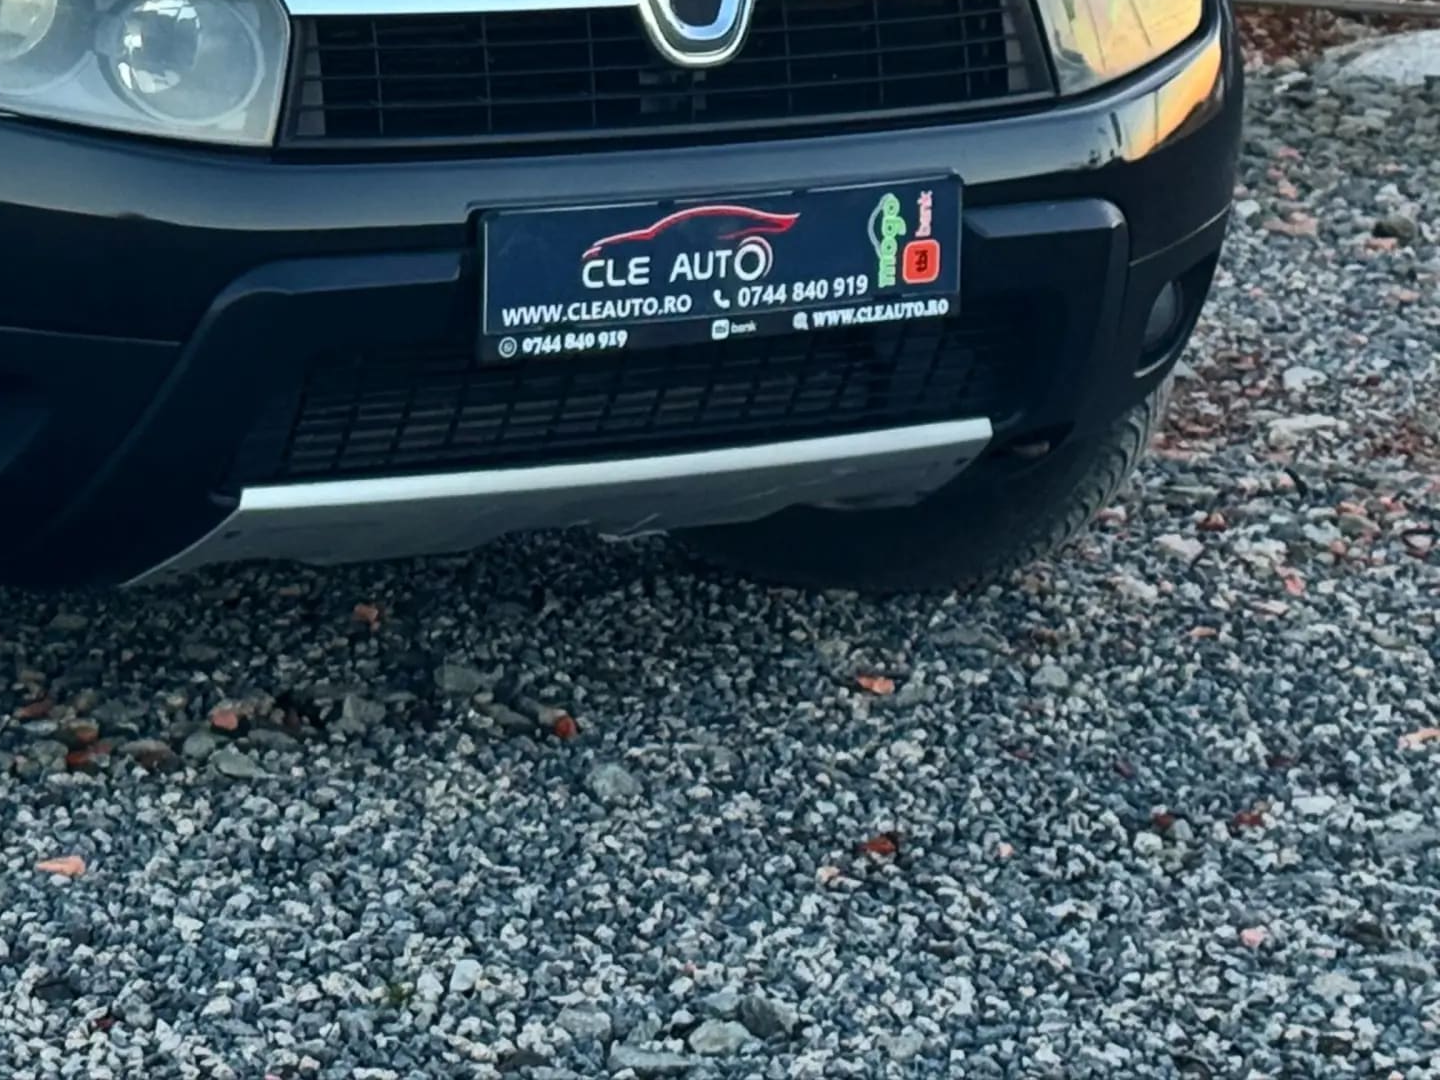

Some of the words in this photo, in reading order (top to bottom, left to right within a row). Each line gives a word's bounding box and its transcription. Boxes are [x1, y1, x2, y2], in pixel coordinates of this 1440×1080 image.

[582, 256, 650, 289] CLE
[670, 242, 768, 283] AUTO
[502, 293, 693, 327] WWW.CLEAUTO.RO
[737, 286, 787, 307] 0744
[792, 281, 829, 302] 840
[832, 274, 869, 298] 919
[522, 334, 562, 355] 0744
[564, 331, 595, 350] 840
[812, 298, 950, 328] WWW.CLEAUTO.RO
